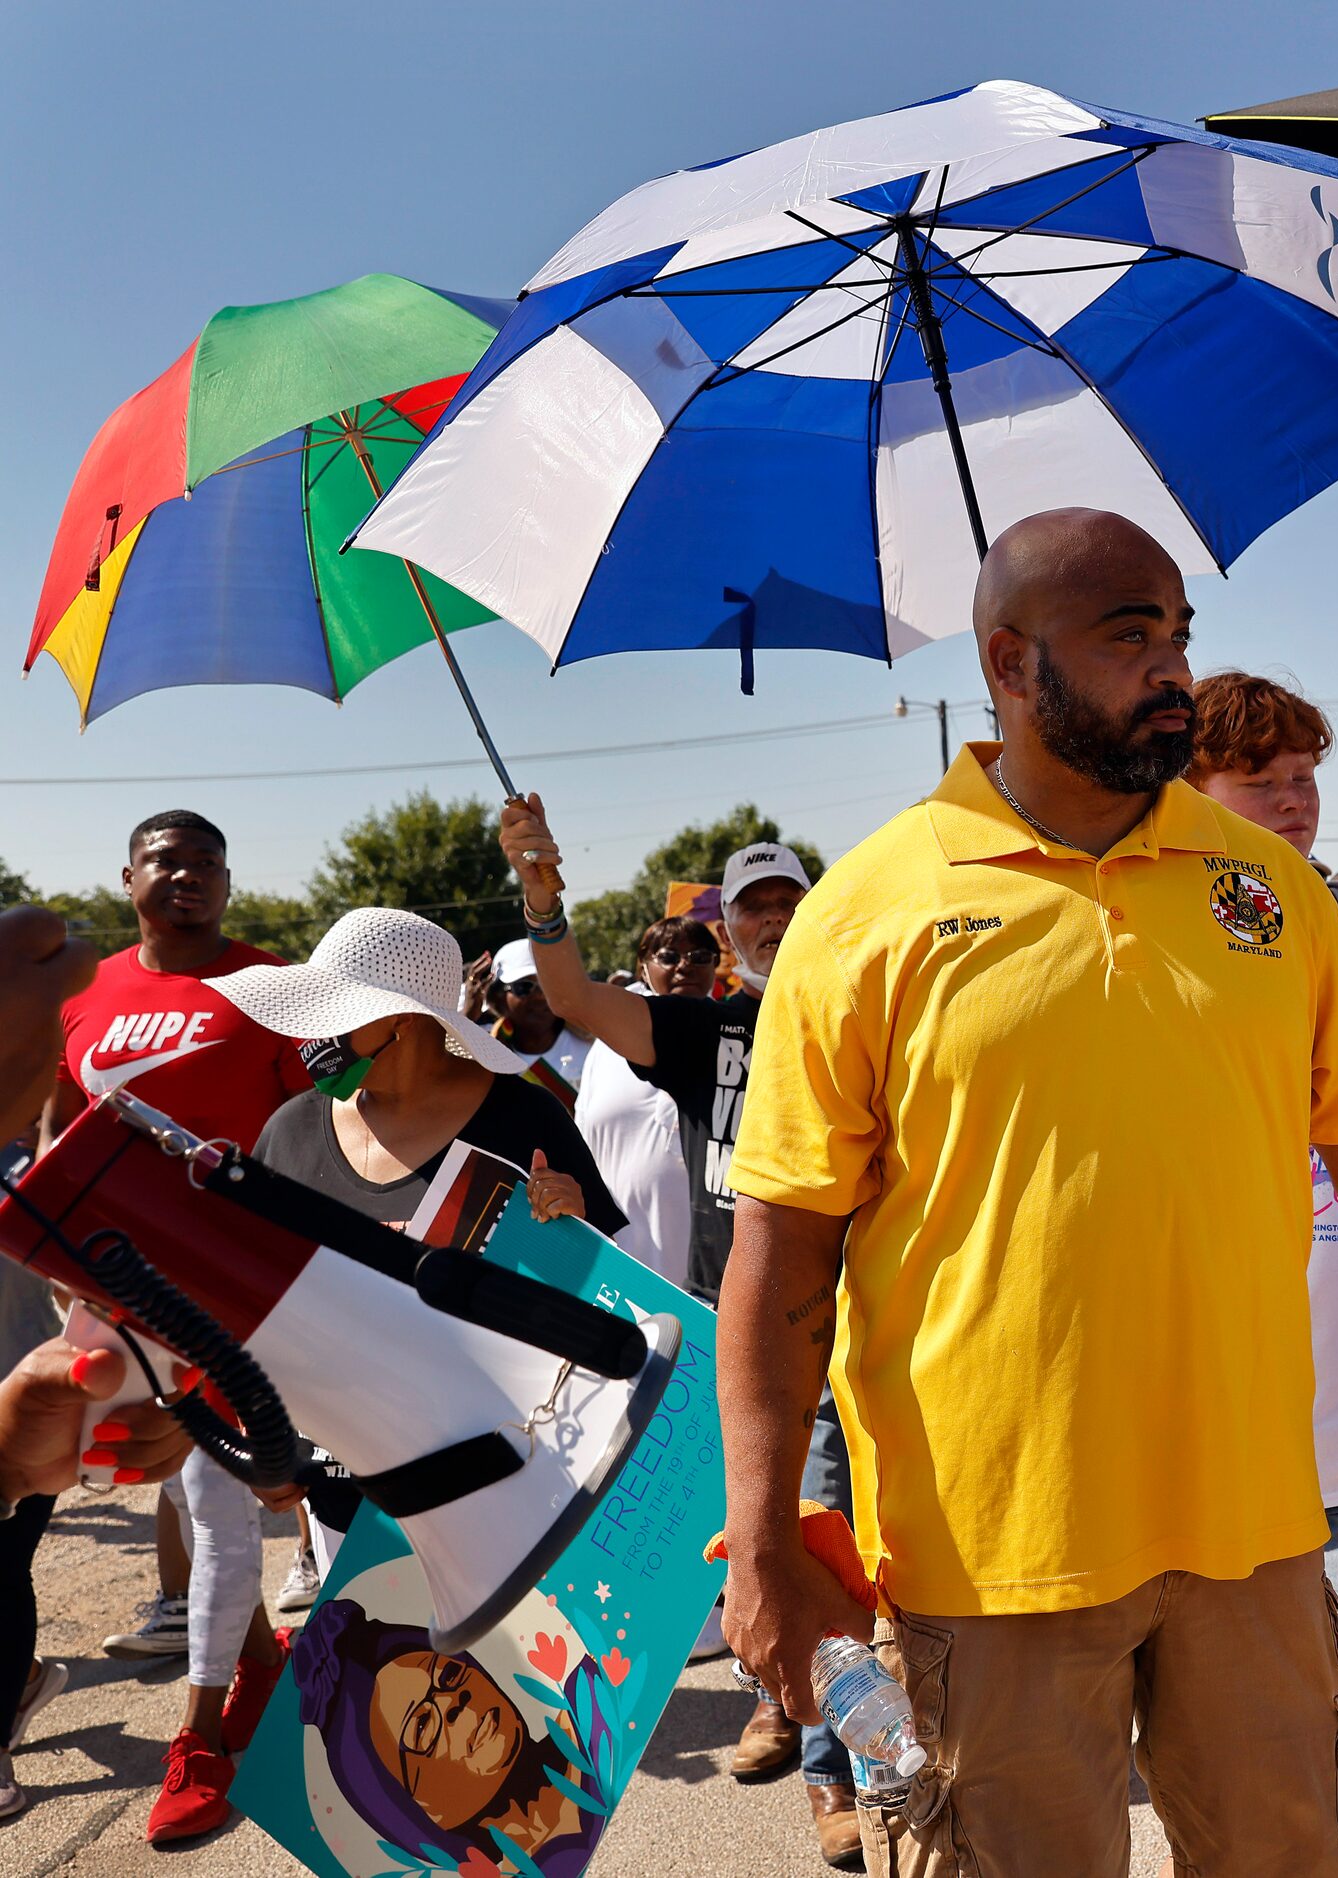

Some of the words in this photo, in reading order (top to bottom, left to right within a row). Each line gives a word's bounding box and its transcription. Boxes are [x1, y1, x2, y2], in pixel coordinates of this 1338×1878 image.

[744, 853, 777, 867] NIKE
[1203, 857, 1272, 881] MWPHGL
[936, 918, 958, 937] RW
[965, 916, 1002, 932] Jones
[1227, 942, 1282, 959] MARYLAND
[98, 1011, 214, 1053] NUPE
[316, 1055, 344, 1070] FREEDOM
[326, 1065, 337, 1074] DAY
[591, 1340, 711, 1557] FREEDOM
[622, 1516, 655, 1571] FROM
[649, 1477, 674, 1512] THE
[685, 1413, 702, 1441] OF
[640, 1552, 663, 1581] TO
[656, 1503, 688, 1546] THE
[698, 1431, 718, 1465] OF
